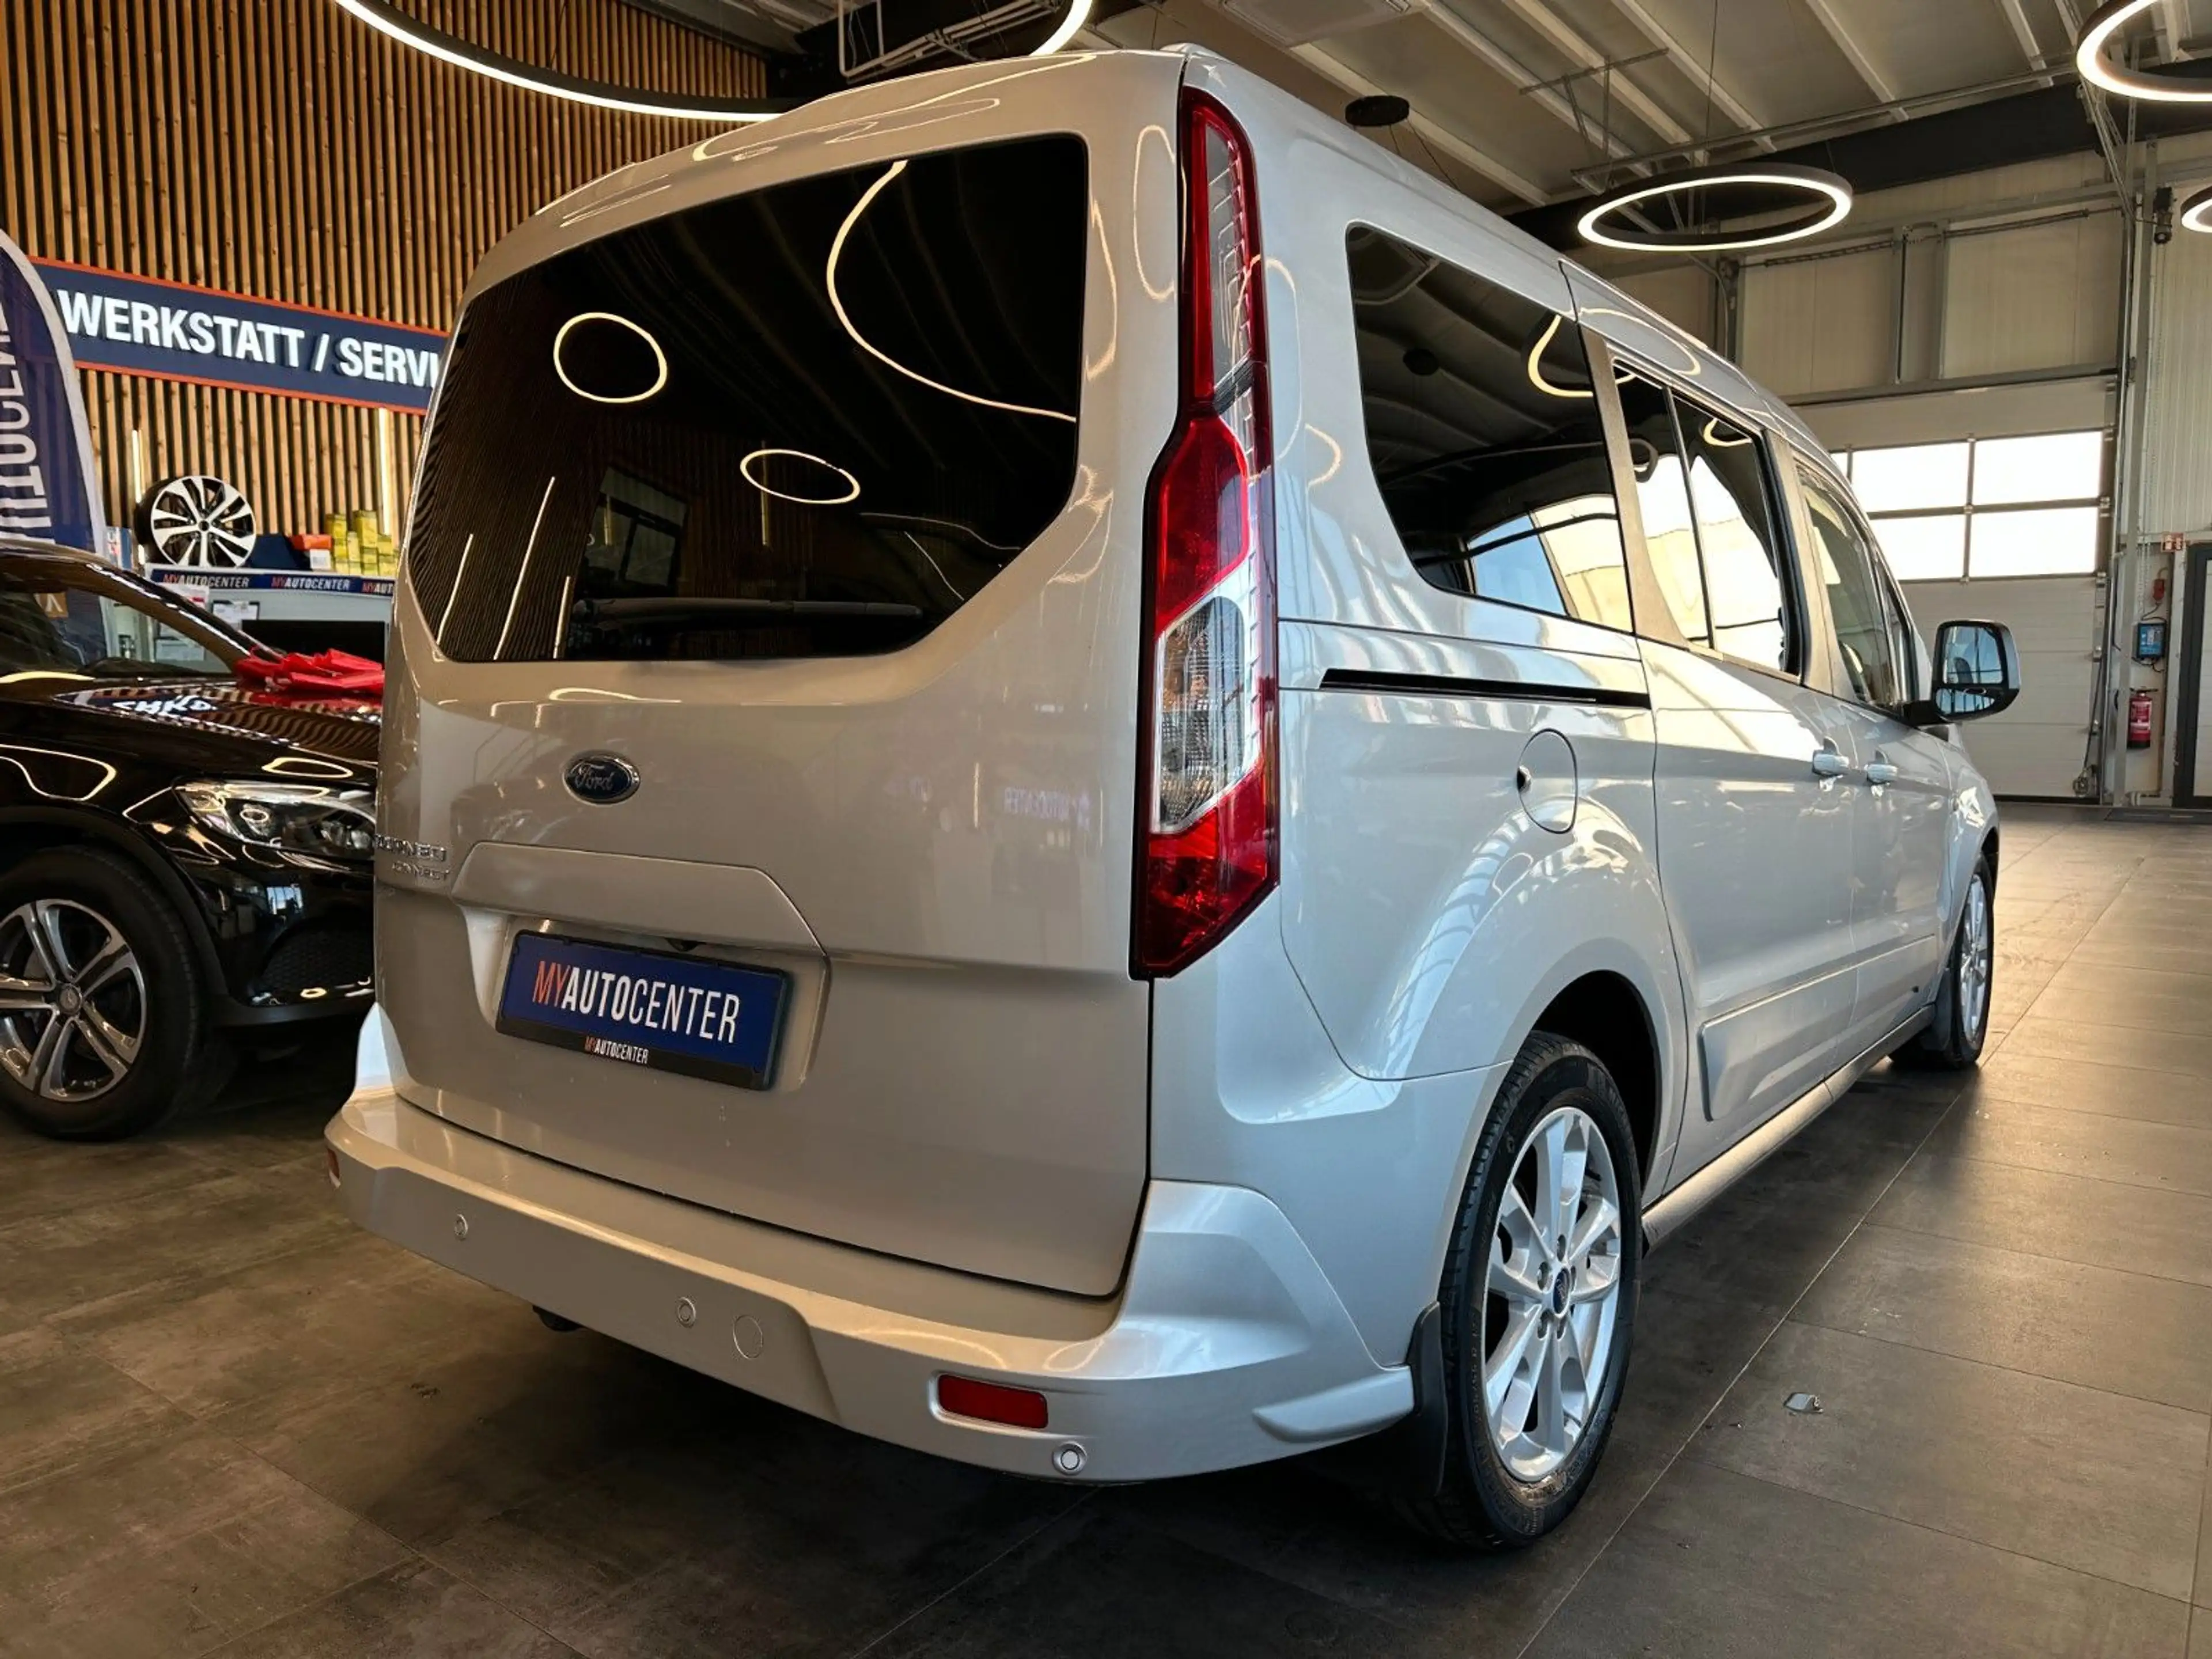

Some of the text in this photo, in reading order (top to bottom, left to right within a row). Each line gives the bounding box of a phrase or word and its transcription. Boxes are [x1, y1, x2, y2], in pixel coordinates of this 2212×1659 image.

[56, 289, 305, 368] WERKSTATT
[315, 333, 330, 372] /
[270, 576, 351, 590] MYAUTOCENTER
[573, 762, 616, 791] Ford
[533, 960, 740, 1043] MYAUTOCENTER
[585, 1036, 649, 1064] MYAUTOCENTER
